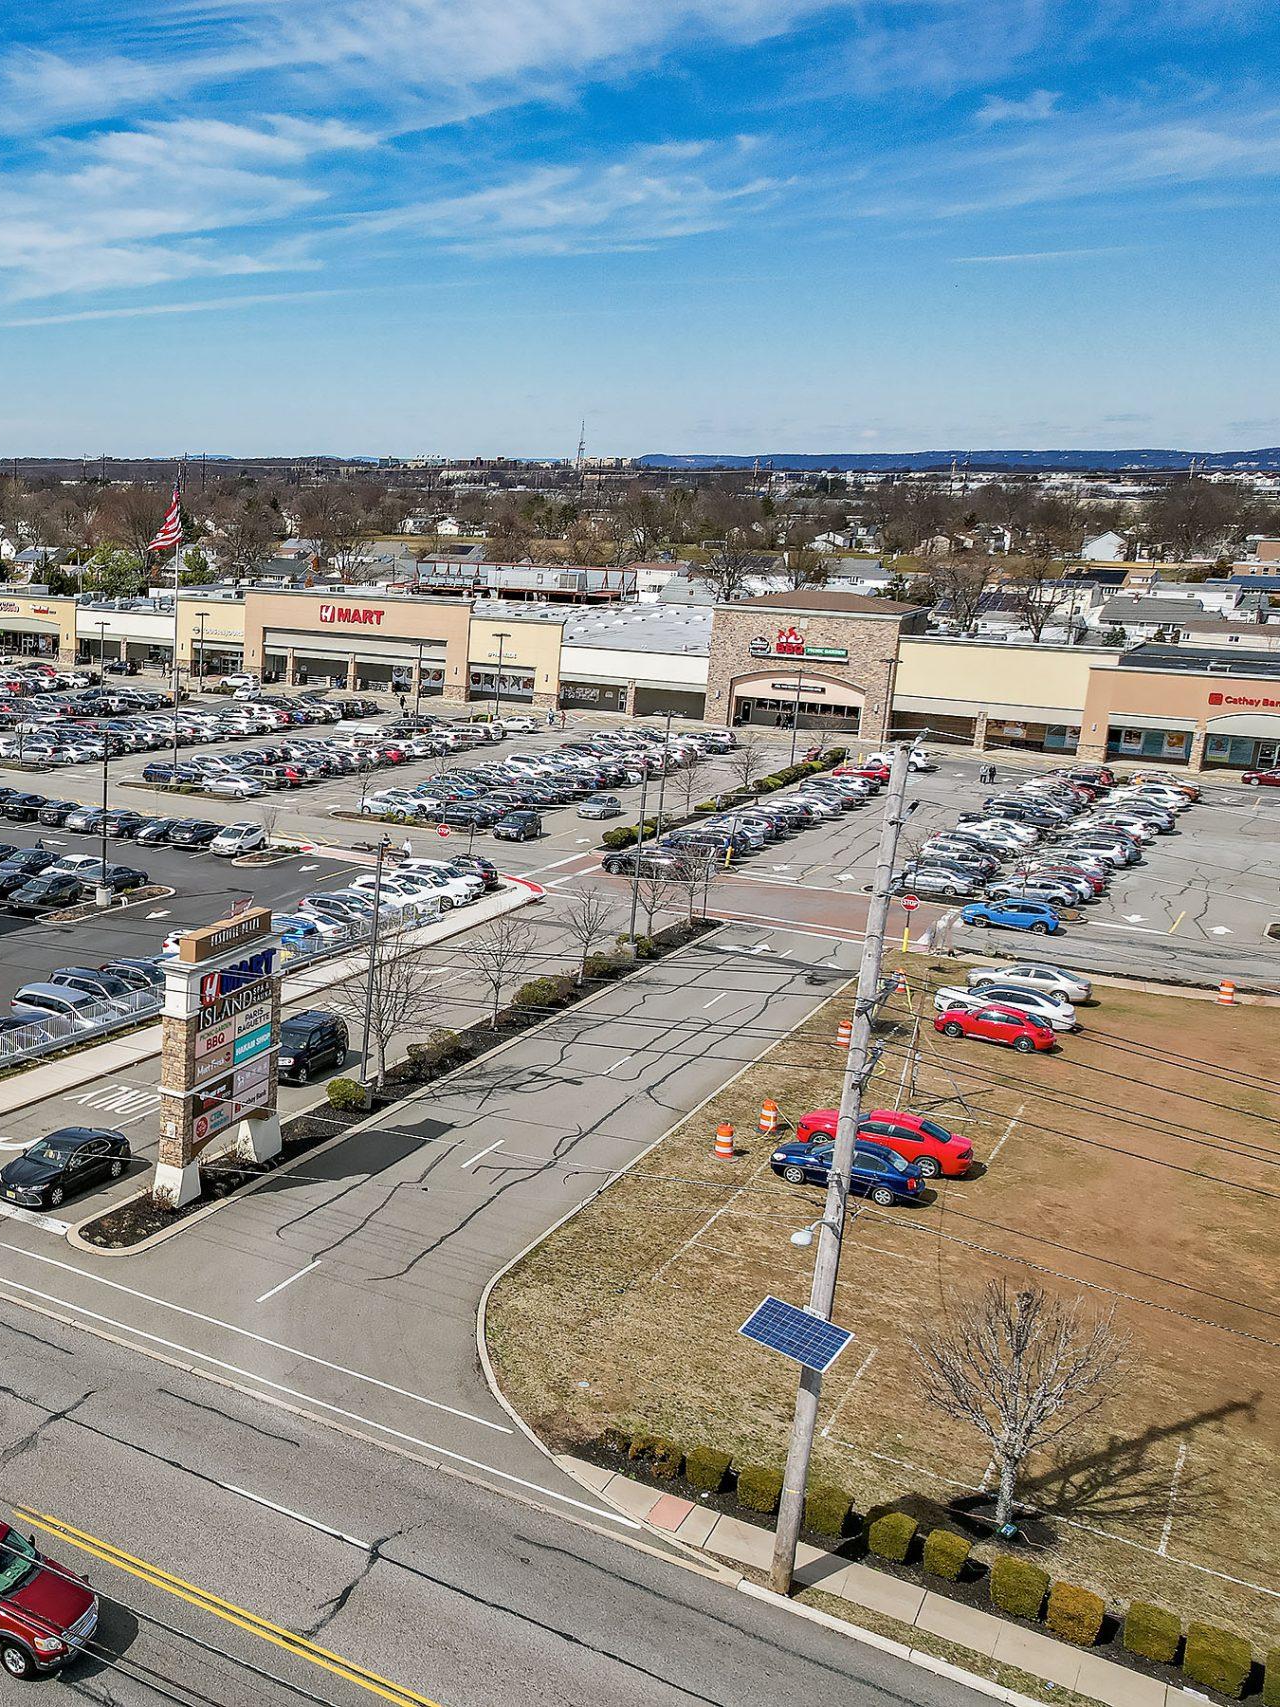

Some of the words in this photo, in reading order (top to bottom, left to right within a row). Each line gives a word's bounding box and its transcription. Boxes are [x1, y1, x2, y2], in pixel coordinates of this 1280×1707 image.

[321, 605, 334, 622] H
[337, 608, 385, 625] MART
[776, 643, 804, 655] BBQ
[1225, 696, 1261, 707] Cathay
[221, 948, 276, 995] MART
[253, 983, 264, 994] SPA
[200, 990, 252, 1030] ISLAND
[245, 1007, 264, 1020] PARIS
[237, 1012, 270, 1034] BAGUETTE
[206, 1032, 225, 1050] BBQ
